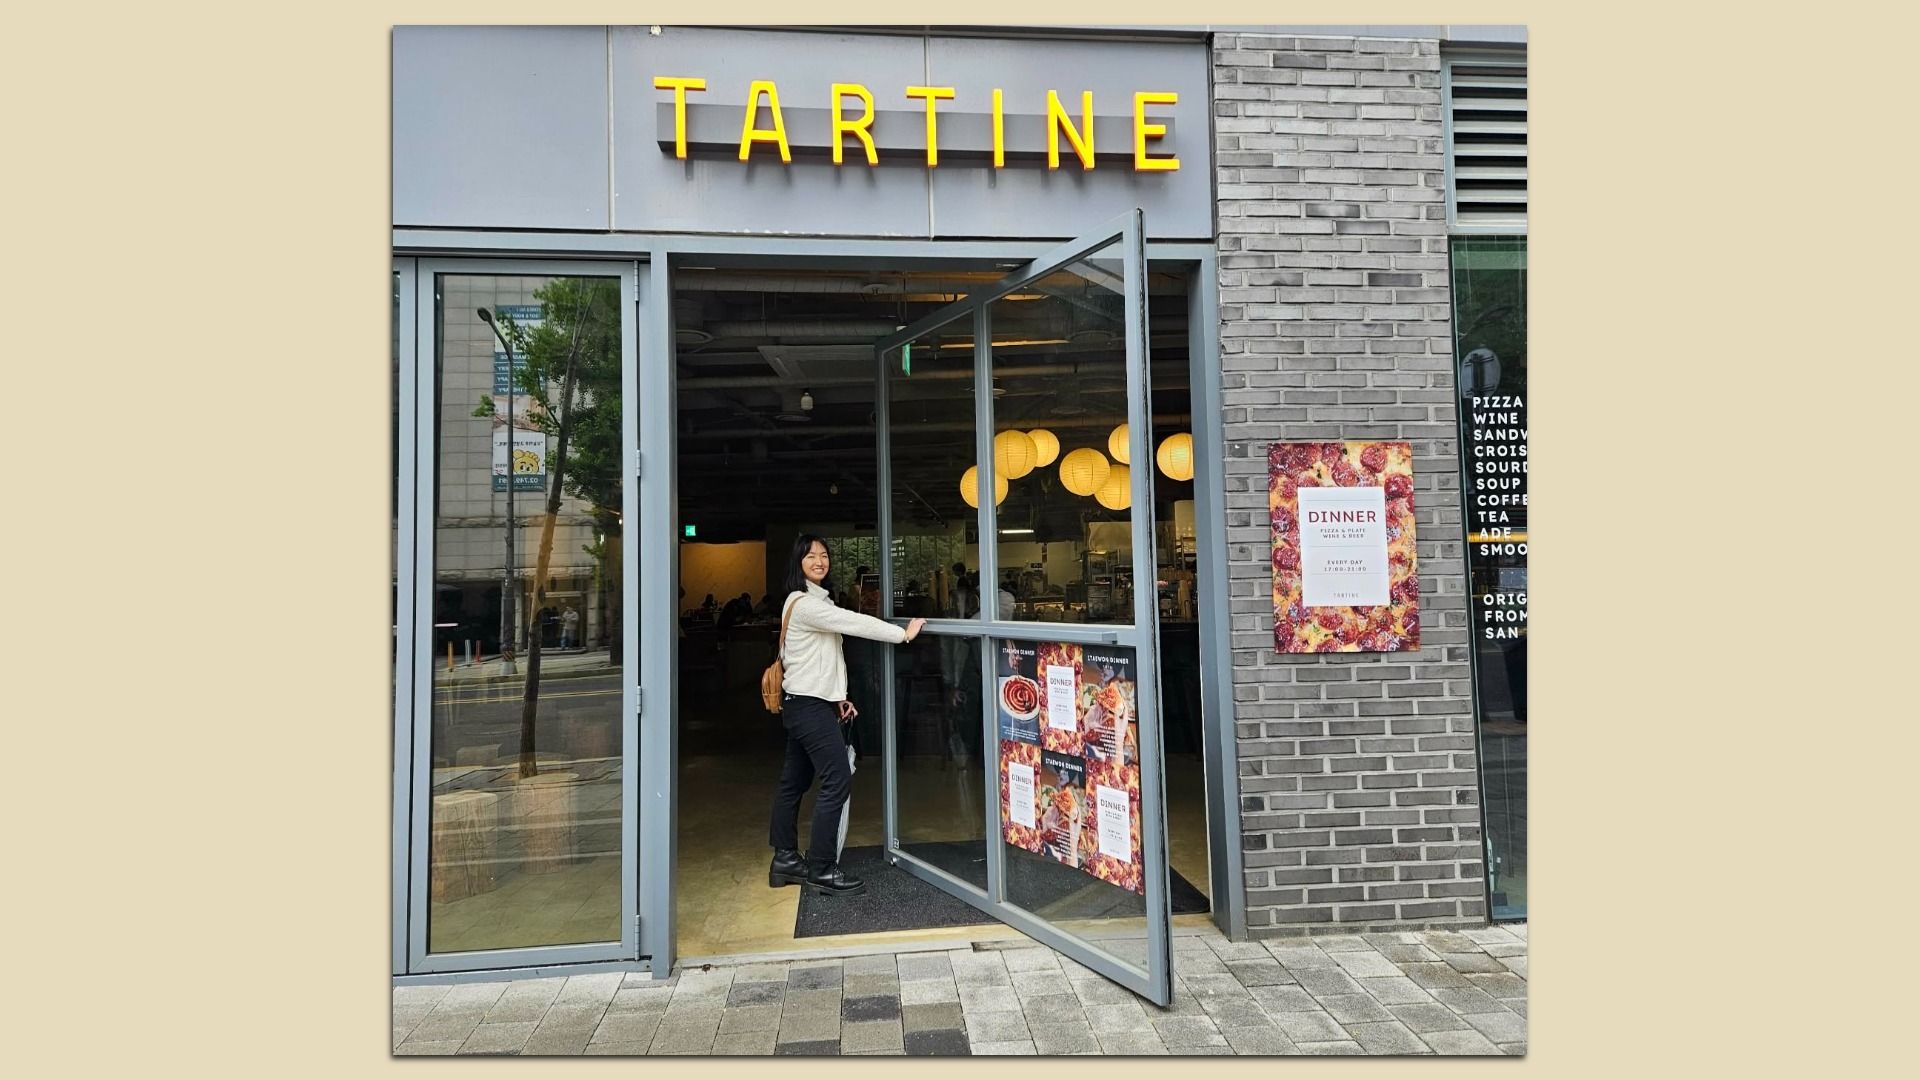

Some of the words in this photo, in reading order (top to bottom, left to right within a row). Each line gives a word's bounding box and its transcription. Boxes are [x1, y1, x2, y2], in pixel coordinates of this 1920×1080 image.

[654, 76, 1180, 172] TARTINE
[1473, 396, 1523, 408] PIZZA
[1473, 412, 1518, 424] WINE
[1474, 445, 1527, 457] CROIS
[1476, 478, 1520, 490] SOUP
[1308, 510, 1376, 523] DINNER
[1478, 511, 1509, 523] TEA
[1480, 527, 1512, 539] ADE
[1480, 544, 1527, 556] SMOO
[1483, 593, 1527, 606] ORIG
[1485, 627, 1518, 639] SAN
[1049, 677, 1073, 687] DINNER
[1011, 774, 1033, 785] DINNER
[1100, 798, 1126, 813] DINNER
